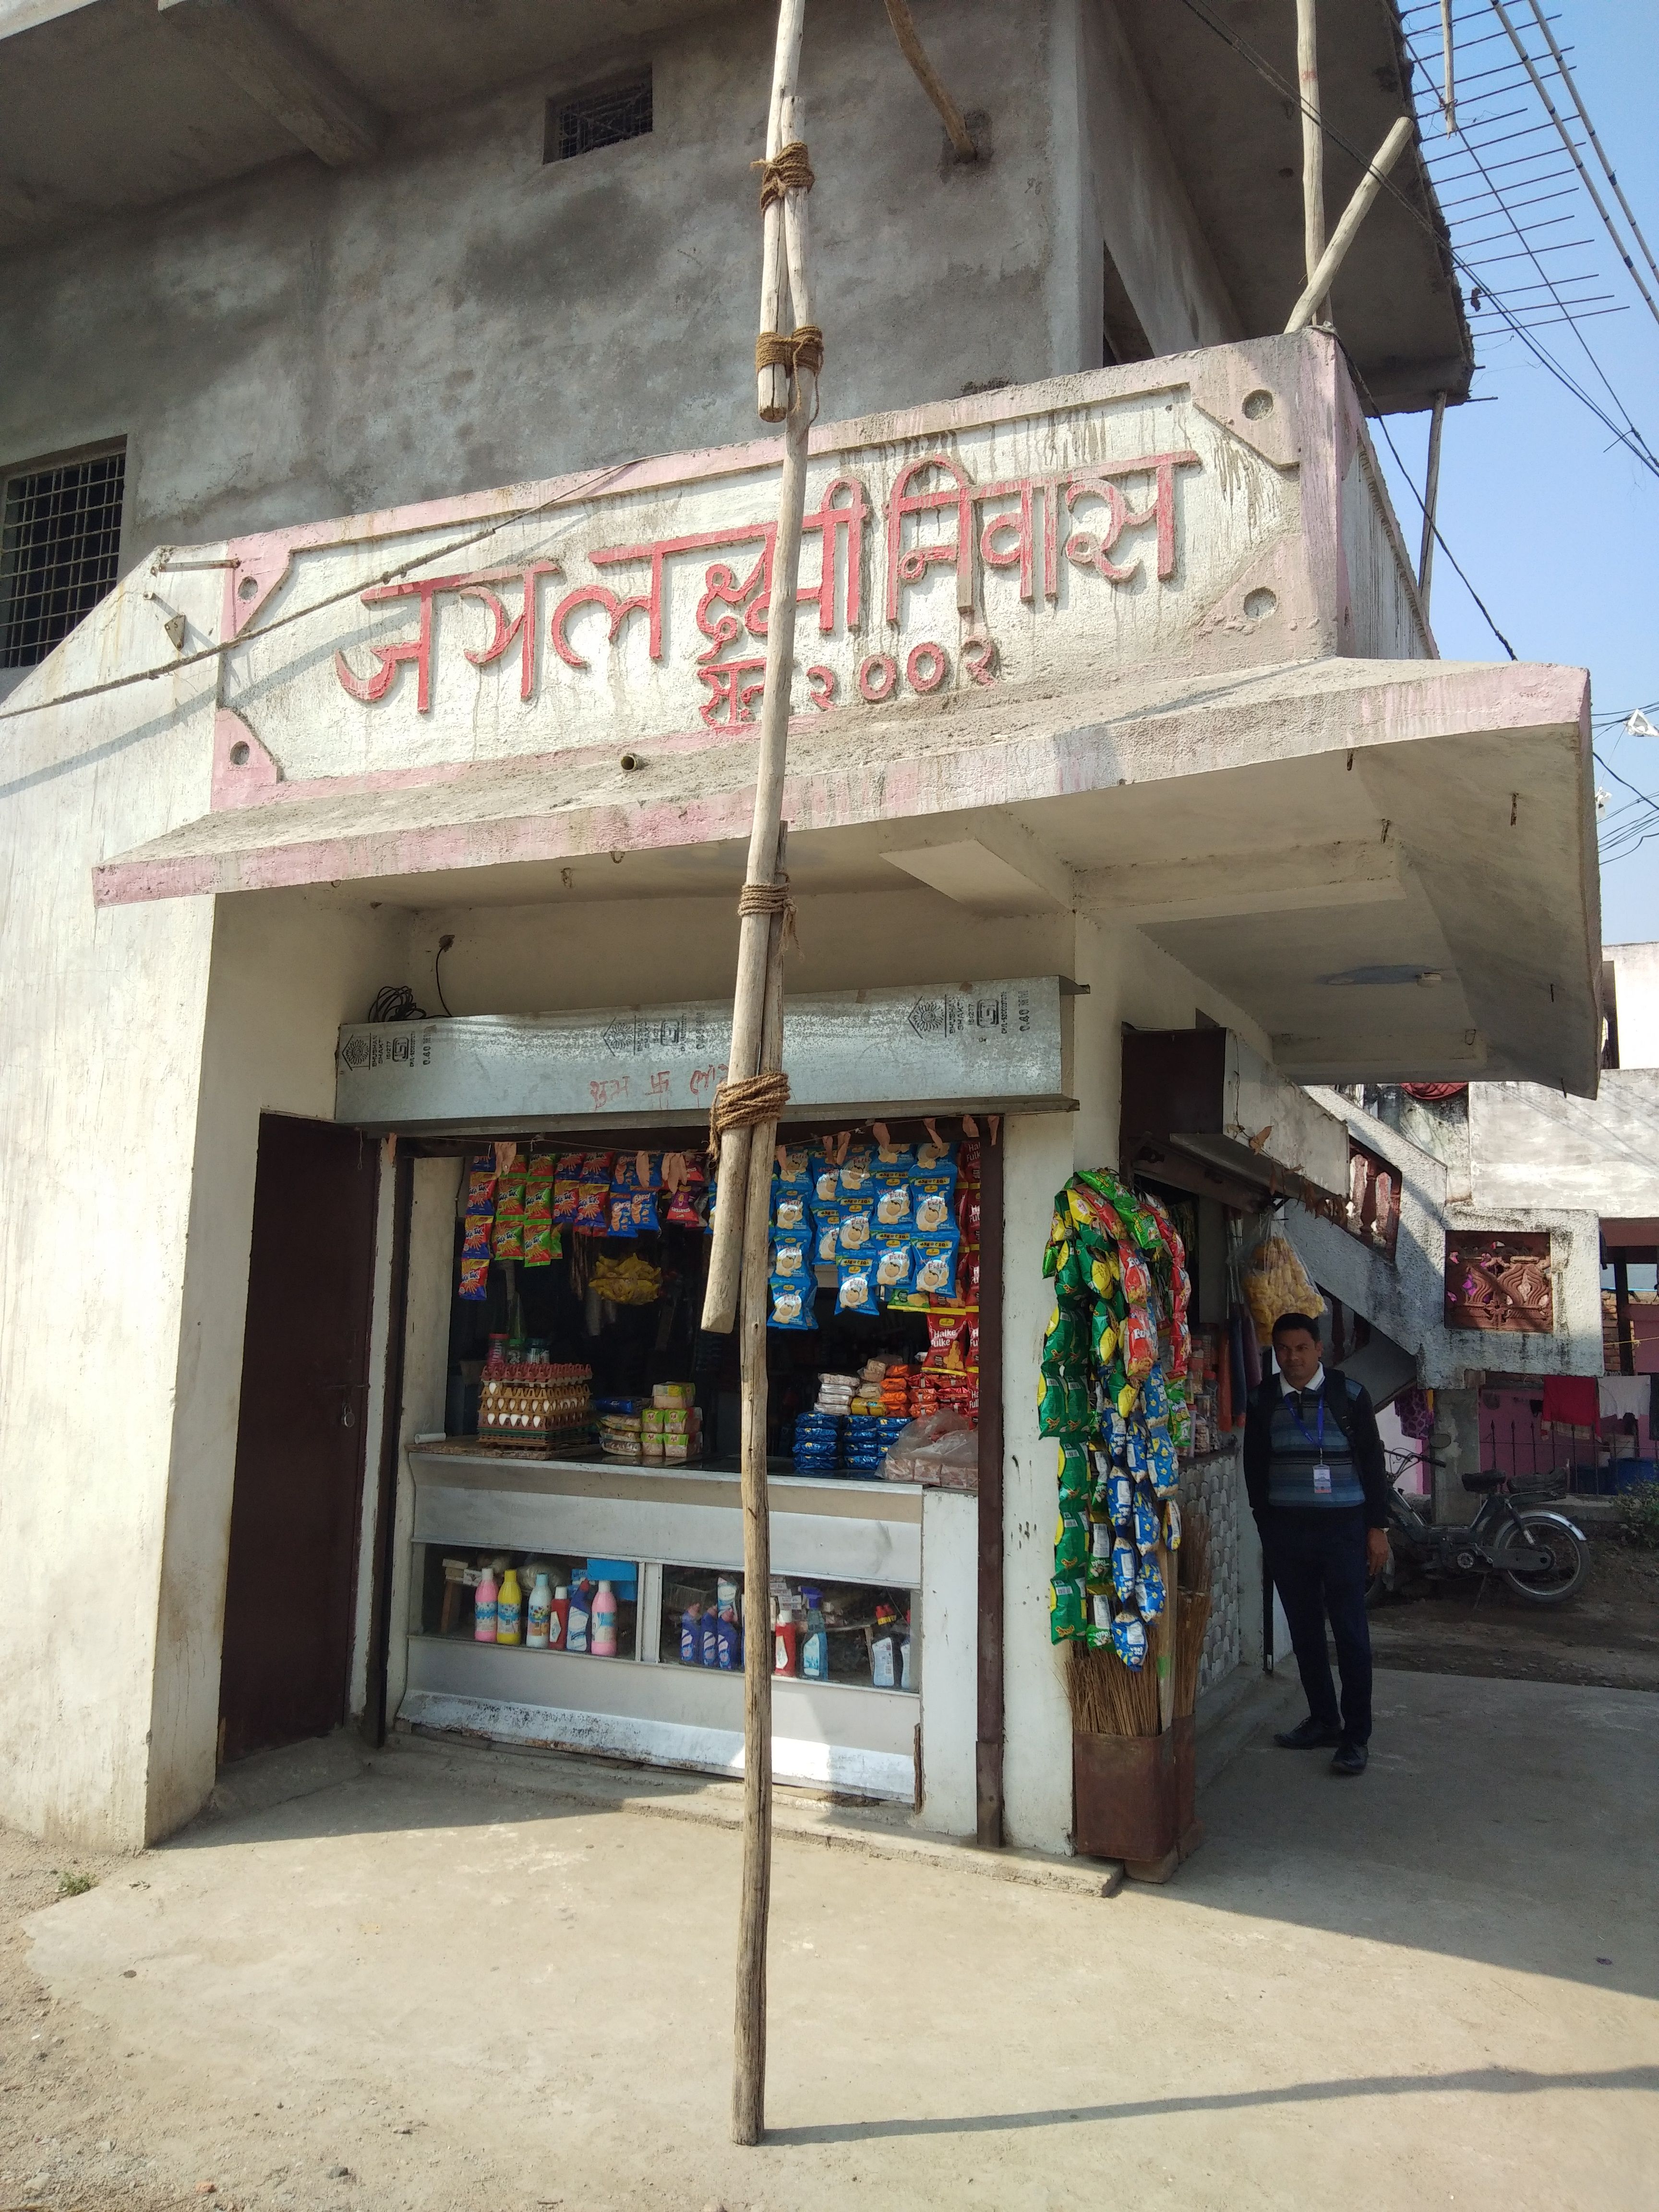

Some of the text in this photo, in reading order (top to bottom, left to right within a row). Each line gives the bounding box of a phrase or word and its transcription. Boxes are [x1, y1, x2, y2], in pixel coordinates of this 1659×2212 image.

[884, 450, 1200, 623] निवास
[1019, 1009, 1030, 1032] 0.40
[969, 1142, 980, 1152] Hal
[967, 1151, 980, 1162] Fulk
[934, 1329, 956, 1338] Halke
